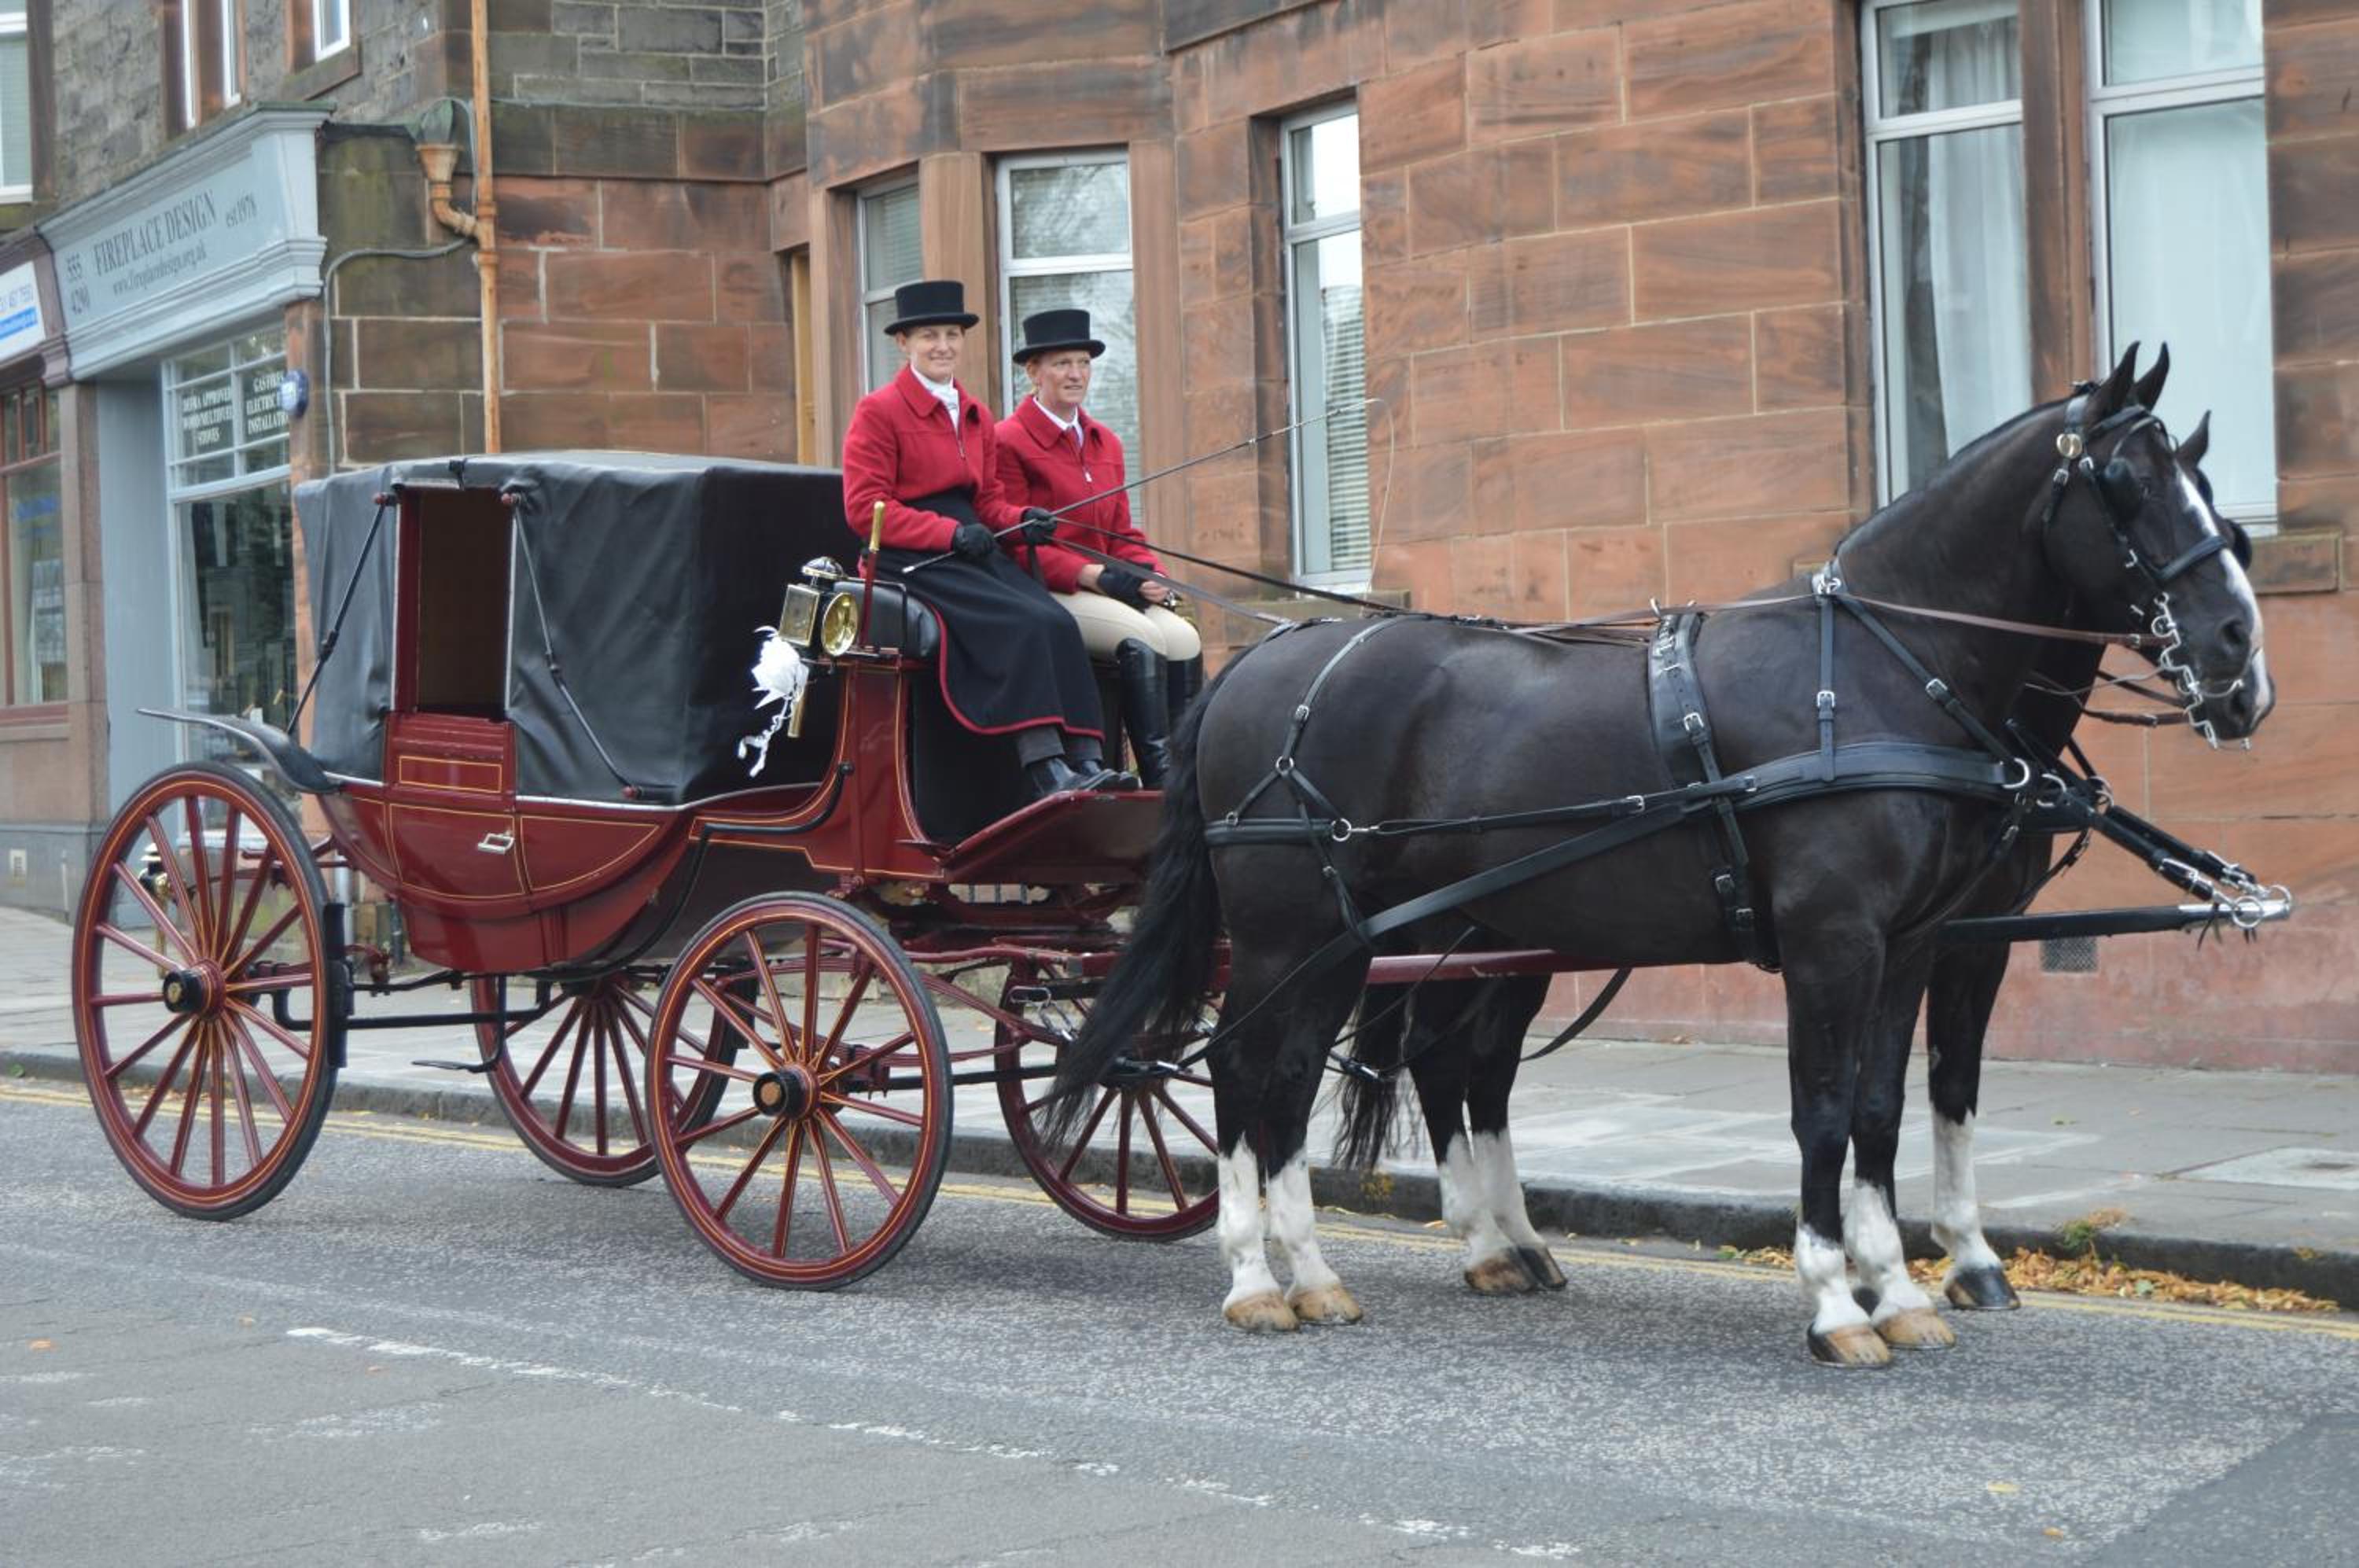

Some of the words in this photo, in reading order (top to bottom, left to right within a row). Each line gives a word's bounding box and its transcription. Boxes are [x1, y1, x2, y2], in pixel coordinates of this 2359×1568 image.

[94, 219, 164, 276] FIREPLACE
[165, 189, 216, 245] DESIGN
[66, 252, 83, 282] 555
